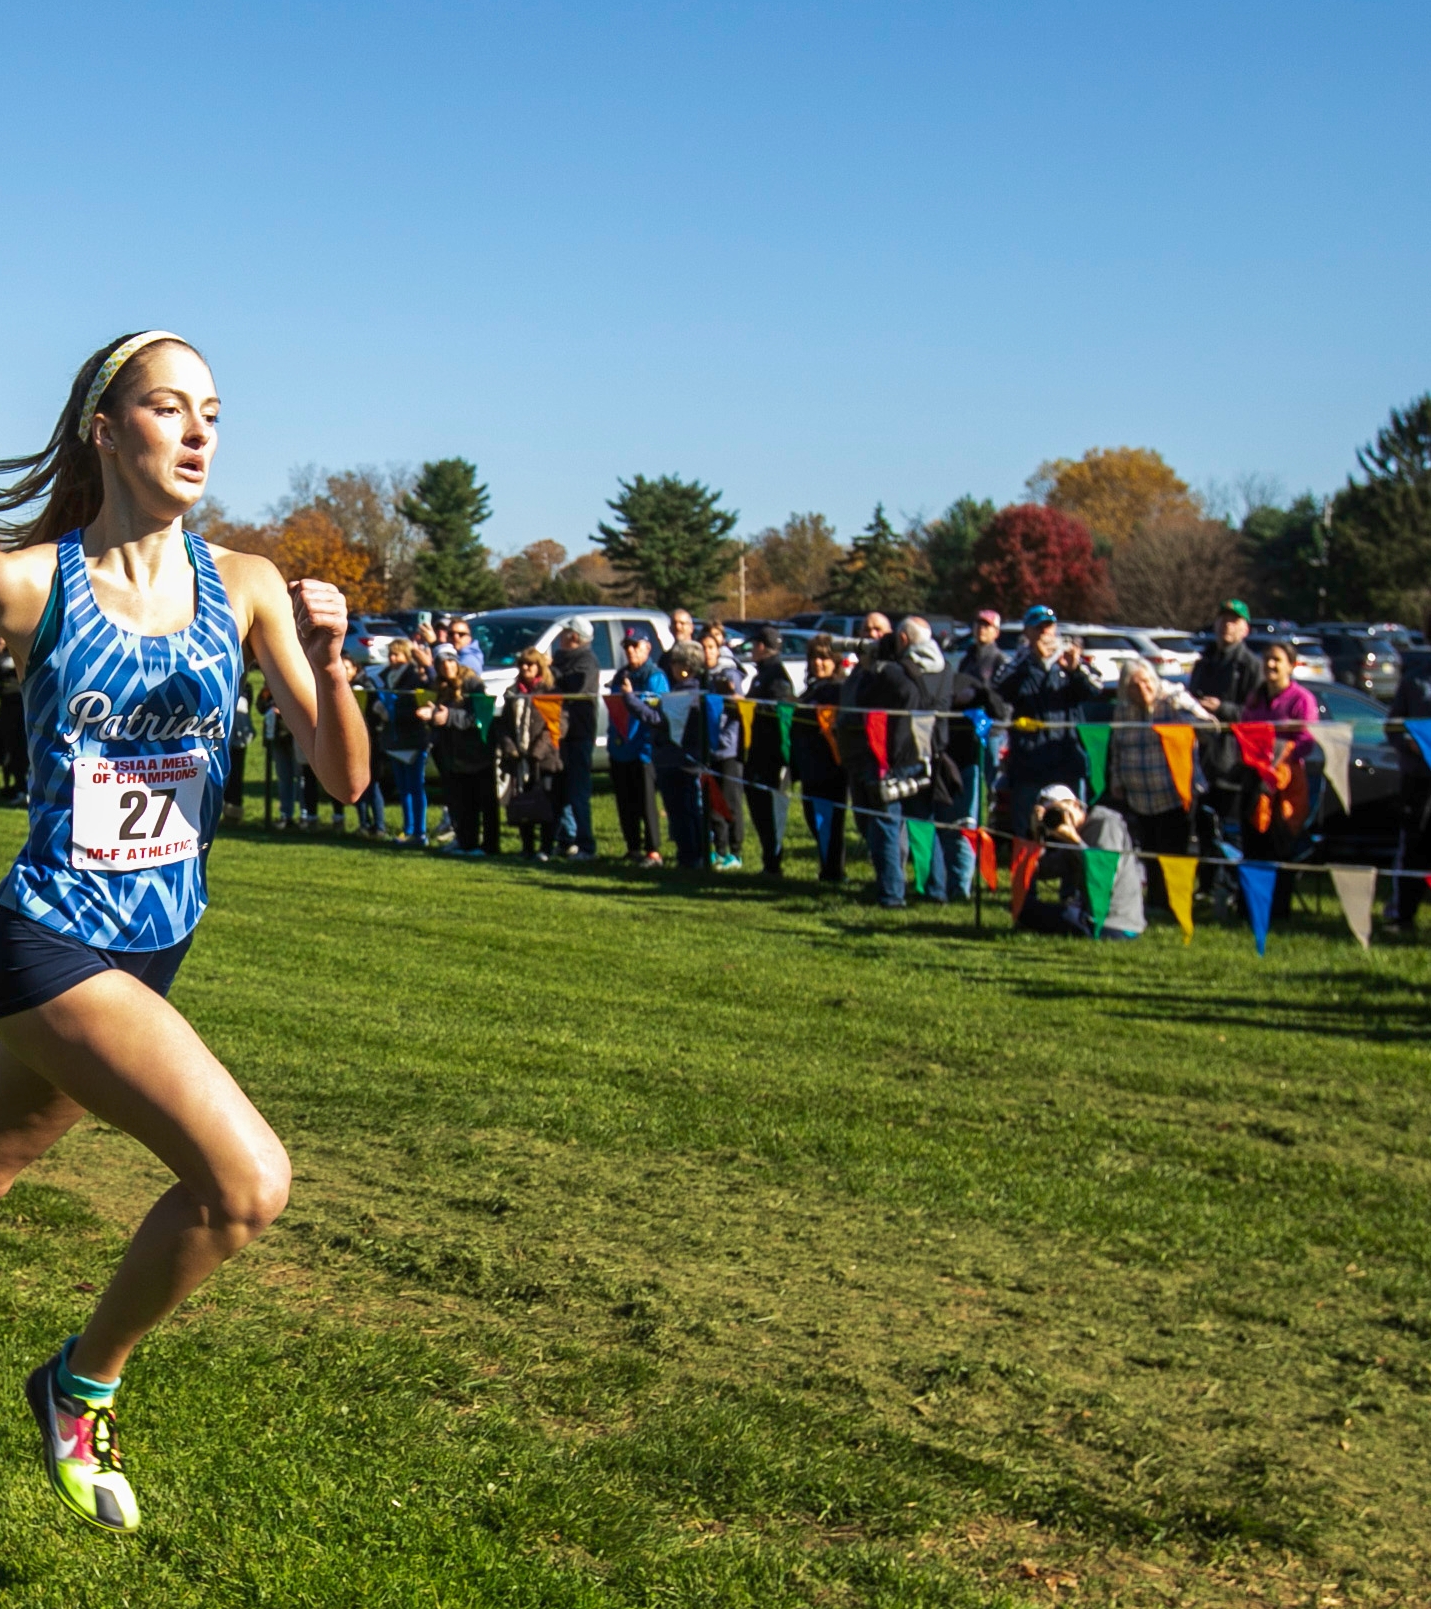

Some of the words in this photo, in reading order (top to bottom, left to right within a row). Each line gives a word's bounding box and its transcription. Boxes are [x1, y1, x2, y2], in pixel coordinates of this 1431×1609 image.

[63, 690, 225, 743] Patriots
[97, 758, 157, 771] NJSIAA
[162, 755, 194, 769] MEET
[92, 773, 111, 784] OF
[116, 767, 198, 784] CHAMPIONS
[119, 788, 177, 840] 27
[86, 848, 120, 860] M-F
